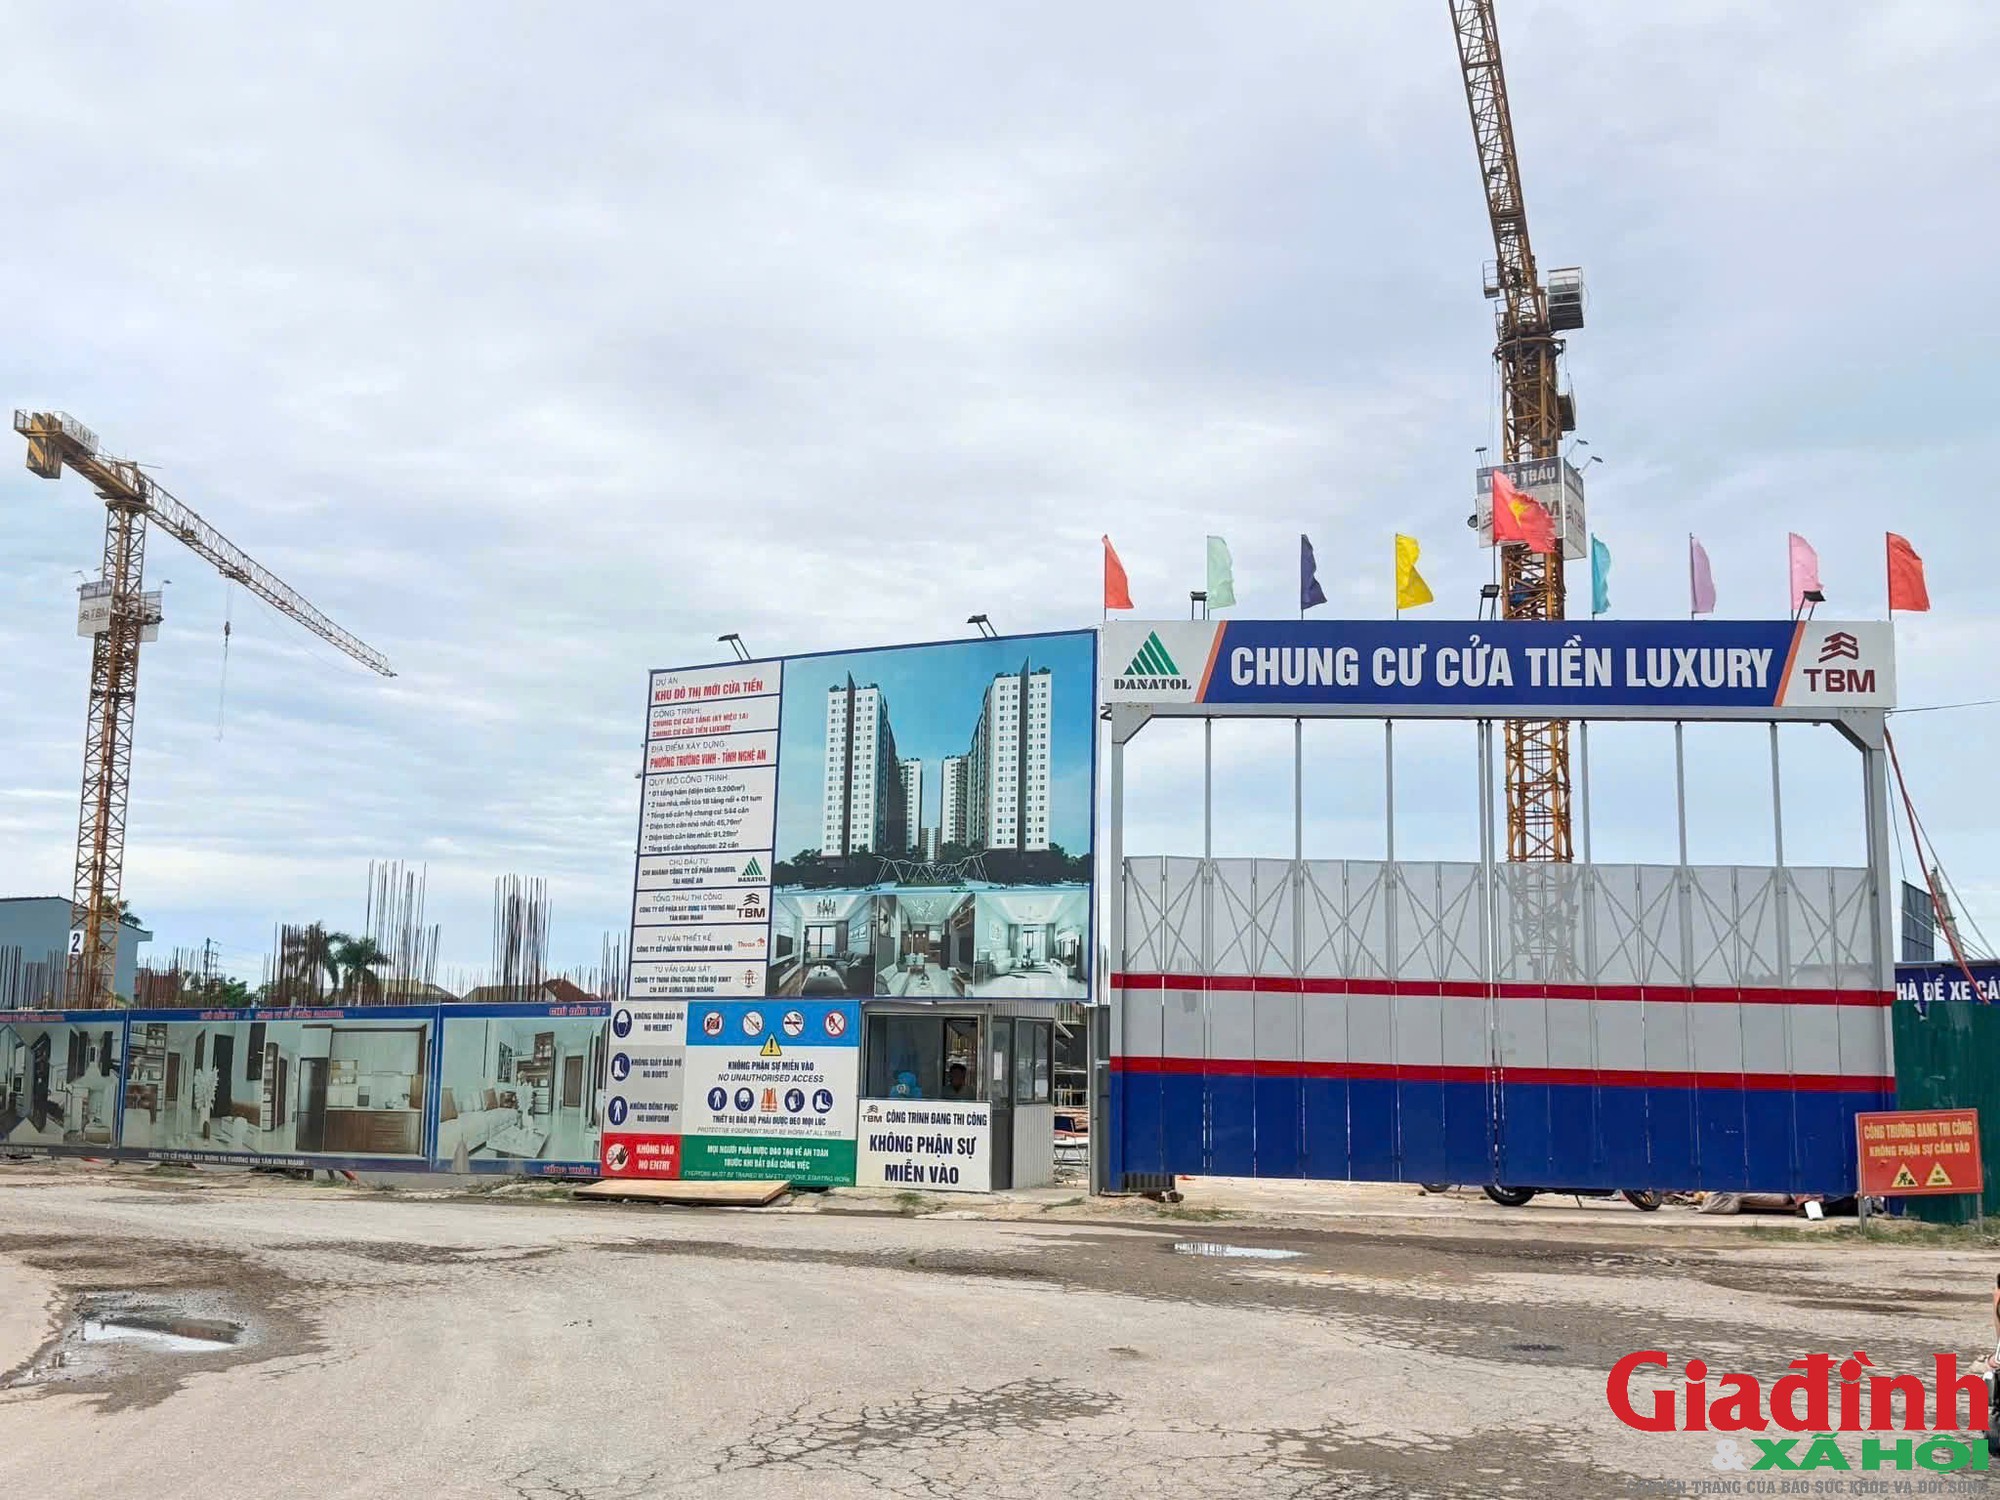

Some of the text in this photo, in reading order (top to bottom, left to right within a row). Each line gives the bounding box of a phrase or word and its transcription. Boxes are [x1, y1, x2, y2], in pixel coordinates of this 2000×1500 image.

[1231, 634, 1773, 689] CHUNG CƯ CỬA TIỀN LUXURY
[1113, 678, 1191, 690] DANATOL
[1803, 668, 1876, 693] TBM
[655, 690, 672, 701] KHU
[674, 686, 686, 699] ĐÔ
[688, 686, 701, 699] THỊ
[704, 683, 720, 696] MỚI
[722, 680, 740, 694] CỬA
[702, 753, 716, 764] VINH
[722, 749, 737, 763] TỈNH
[757, 750, 766, 760] AN
[737, 908, 765, 918] TBM
[71, 932, 80, 952] 2
[1896, 974, 2000, 1000] HÀ ĐỂ XE CÁ
[728, 1060, 750, 1070] KHÔNG
[752, 1060, 769, 1072] PHẬN
[771, 1061, 781, 1072] SỰ
[801, 1060, 814, 1071] VÀO
[731, 1074, 790, 1082] UNAUTHORISED
[792, 1074, 824, 1083] ACCESS
[862, 1115, 883, 1123] TBM
[886, 1109, 987, 1126] CÔNG TRÌNH ĐANG THI CÔNG
[1864, 1122, 1885, 1139] CÔNG
[1886, 1121, 1916, 1138] TRƯỜNG
[1938, 1122, 1951, 1136] THI
[1952, 1119, 1972, 1135] CÔNG
[636, 1142, 674, 1154] KHÔNG VÀO
[869, 1132, 976, 1159] KHÔNG PHẬN SỰ
[1870, 1139, 1970, 1158] KHÔNG PHẬN SỰ CẤM VÀO
[638, 1160, 648, 1170] NO
[780, 1159, 795, 1169] CÔNG
[885, 1159, 959, 1185] MIỄN VÀO
